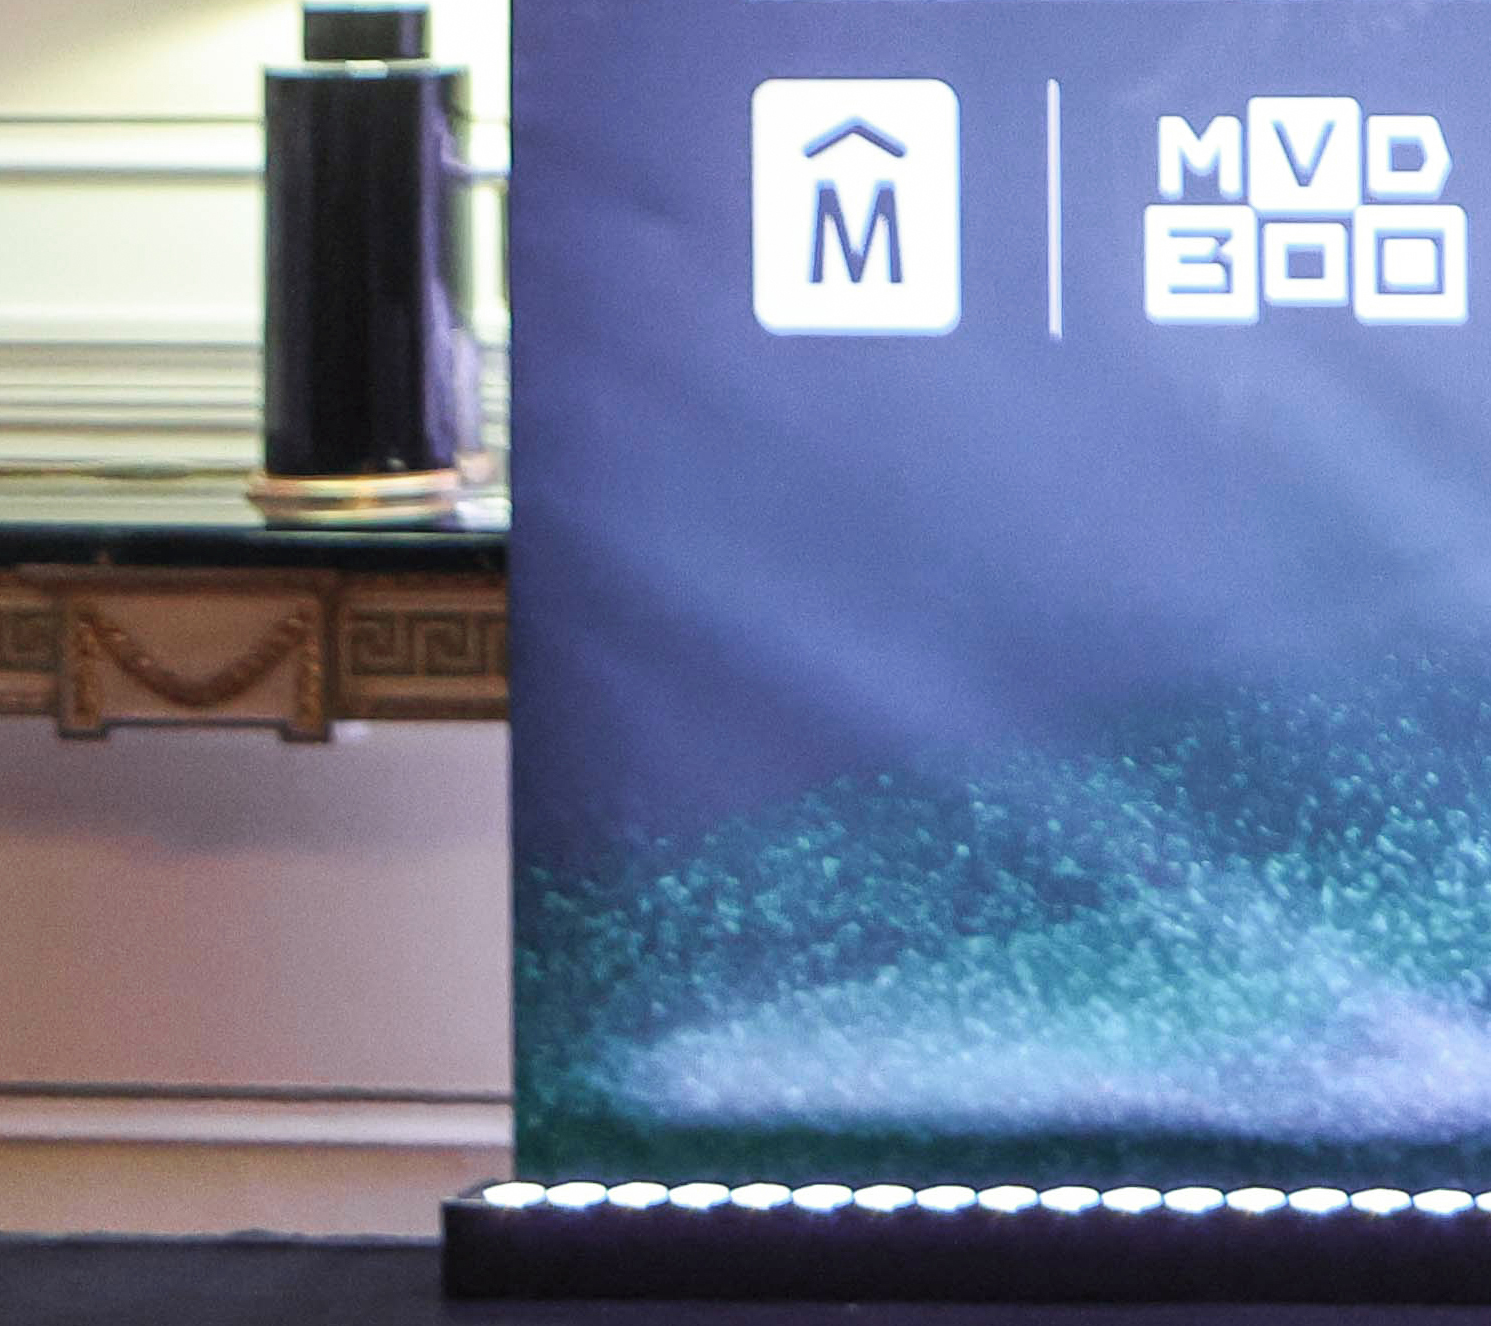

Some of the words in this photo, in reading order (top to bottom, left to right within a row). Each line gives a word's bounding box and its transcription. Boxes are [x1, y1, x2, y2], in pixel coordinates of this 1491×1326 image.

[1158, 105, 1452, 208] MVD
[807, 180, 904, 286] M
[1157, 211, 1456, 316] 300
